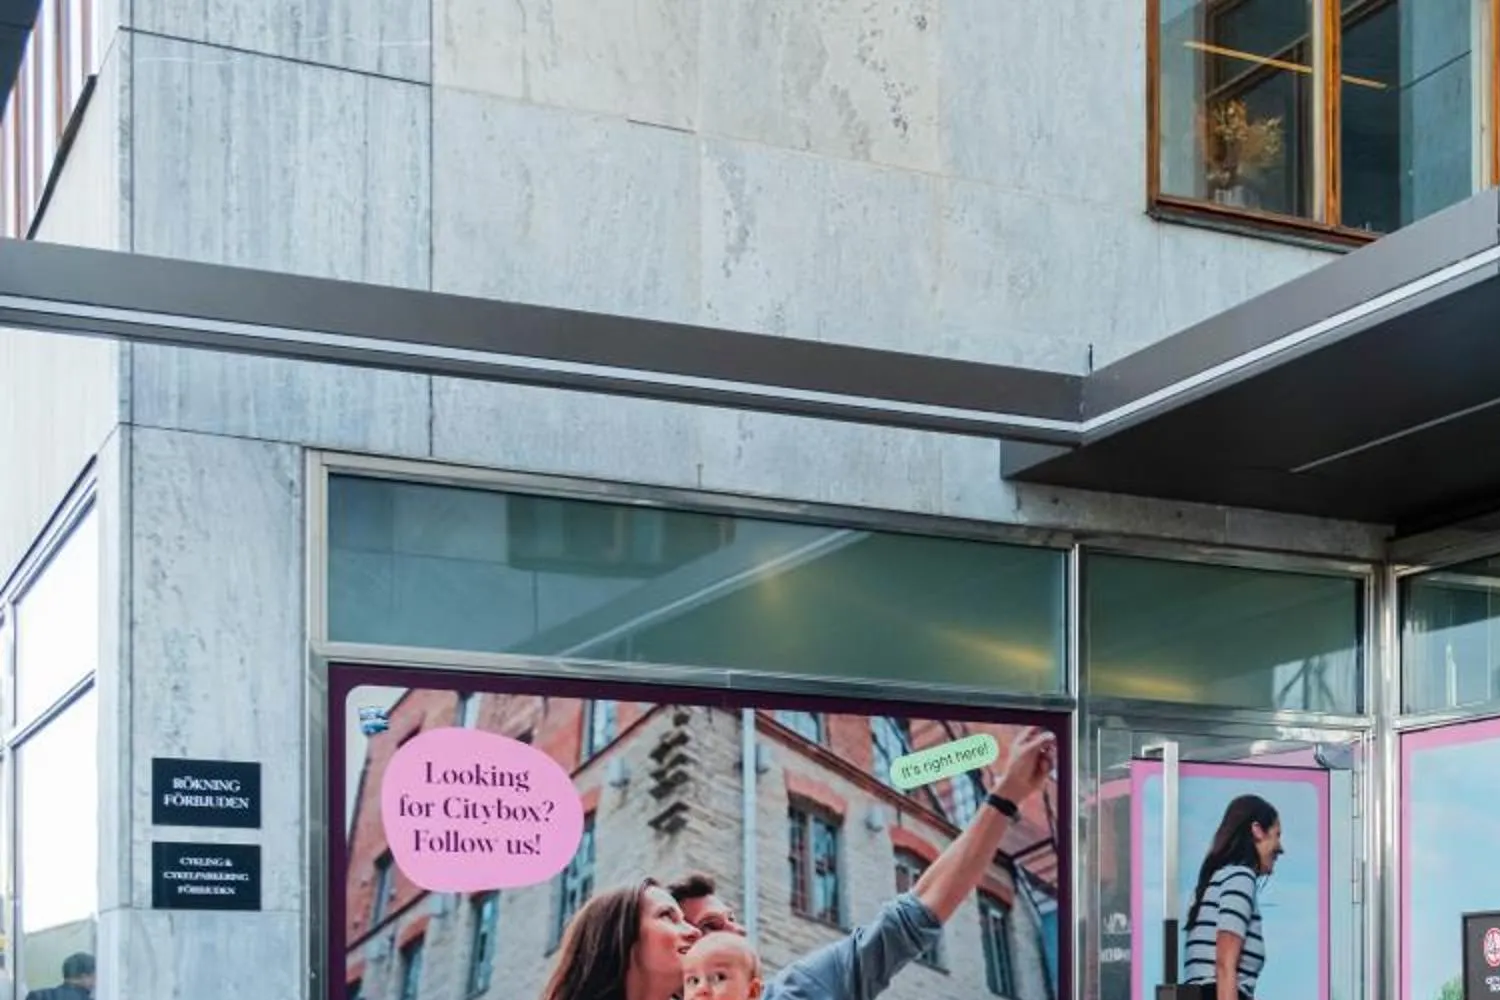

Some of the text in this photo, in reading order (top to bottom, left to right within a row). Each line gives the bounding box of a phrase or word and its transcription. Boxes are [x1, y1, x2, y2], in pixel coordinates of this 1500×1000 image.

[901, 742, 990, 779] It's right here!
[172, 775, 241, 793] RÖKNING
[425, 761, 531, 792] Looking
[399, 794, 555, 825] for Citybox?
[413, 829, 542, 856] Follow us!
